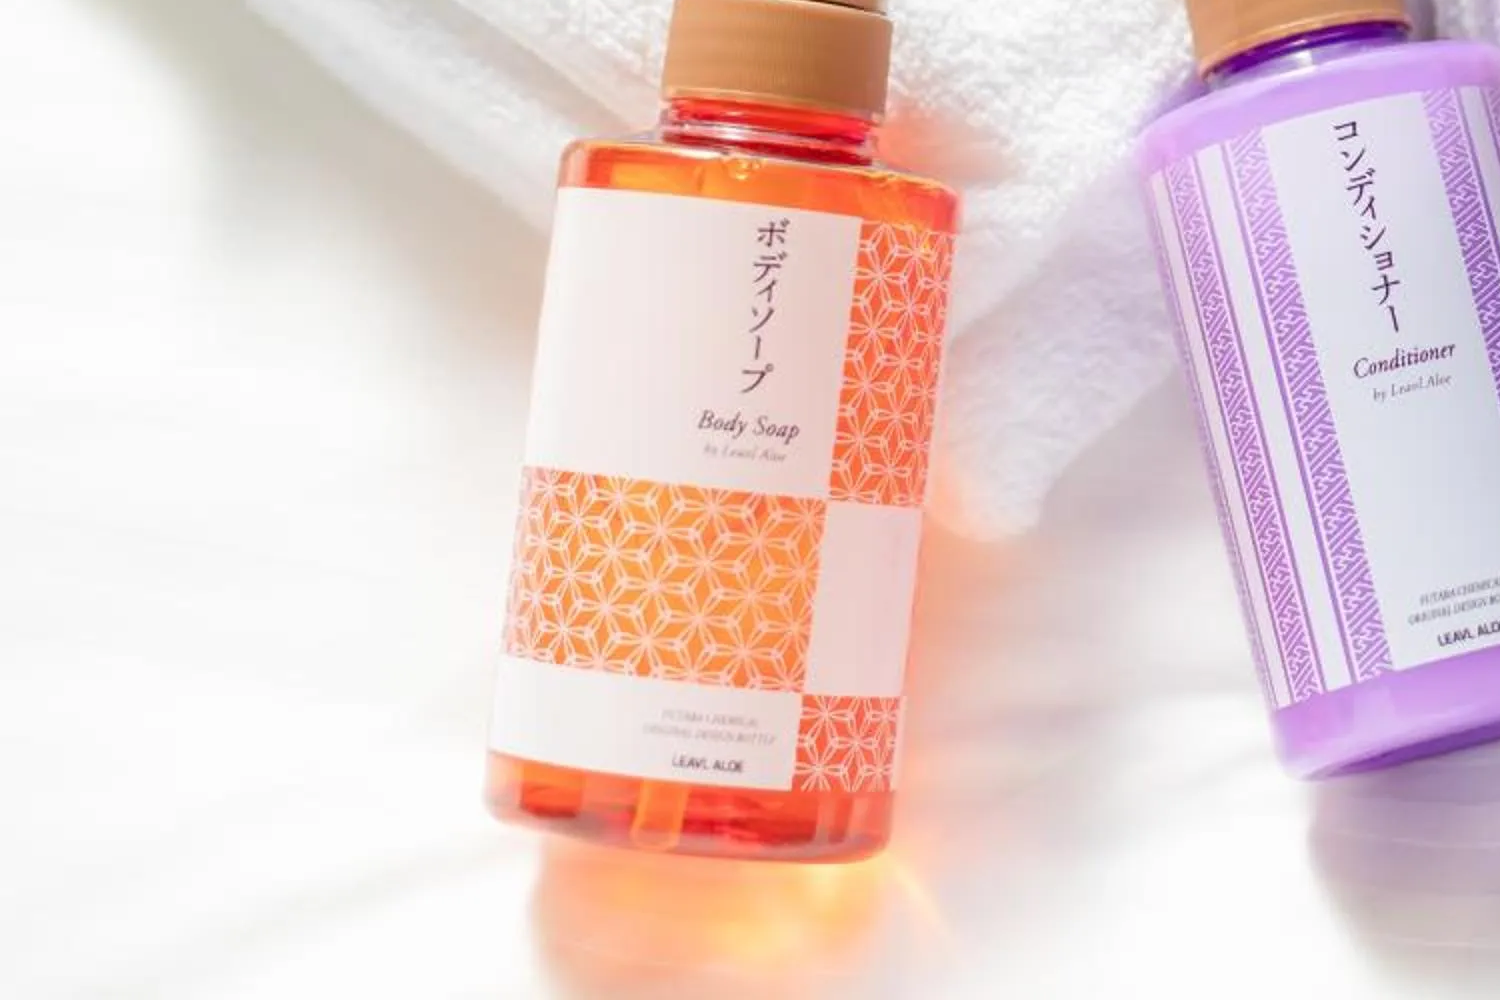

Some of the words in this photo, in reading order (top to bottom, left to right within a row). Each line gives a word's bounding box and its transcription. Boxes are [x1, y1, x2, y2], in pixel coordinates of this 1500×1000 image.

[1333, 120, 1401, 334] コンディショナー
[740, 217, 791, 395] ボディソープ
[1353, 343, 1456, 380] Conditioner
[1372, 387, 1387, 403] by
[697, 409, 748, 440] Body
[752, 414, 801, 446] Soap
[712, 758, 745, 773] ALOE
